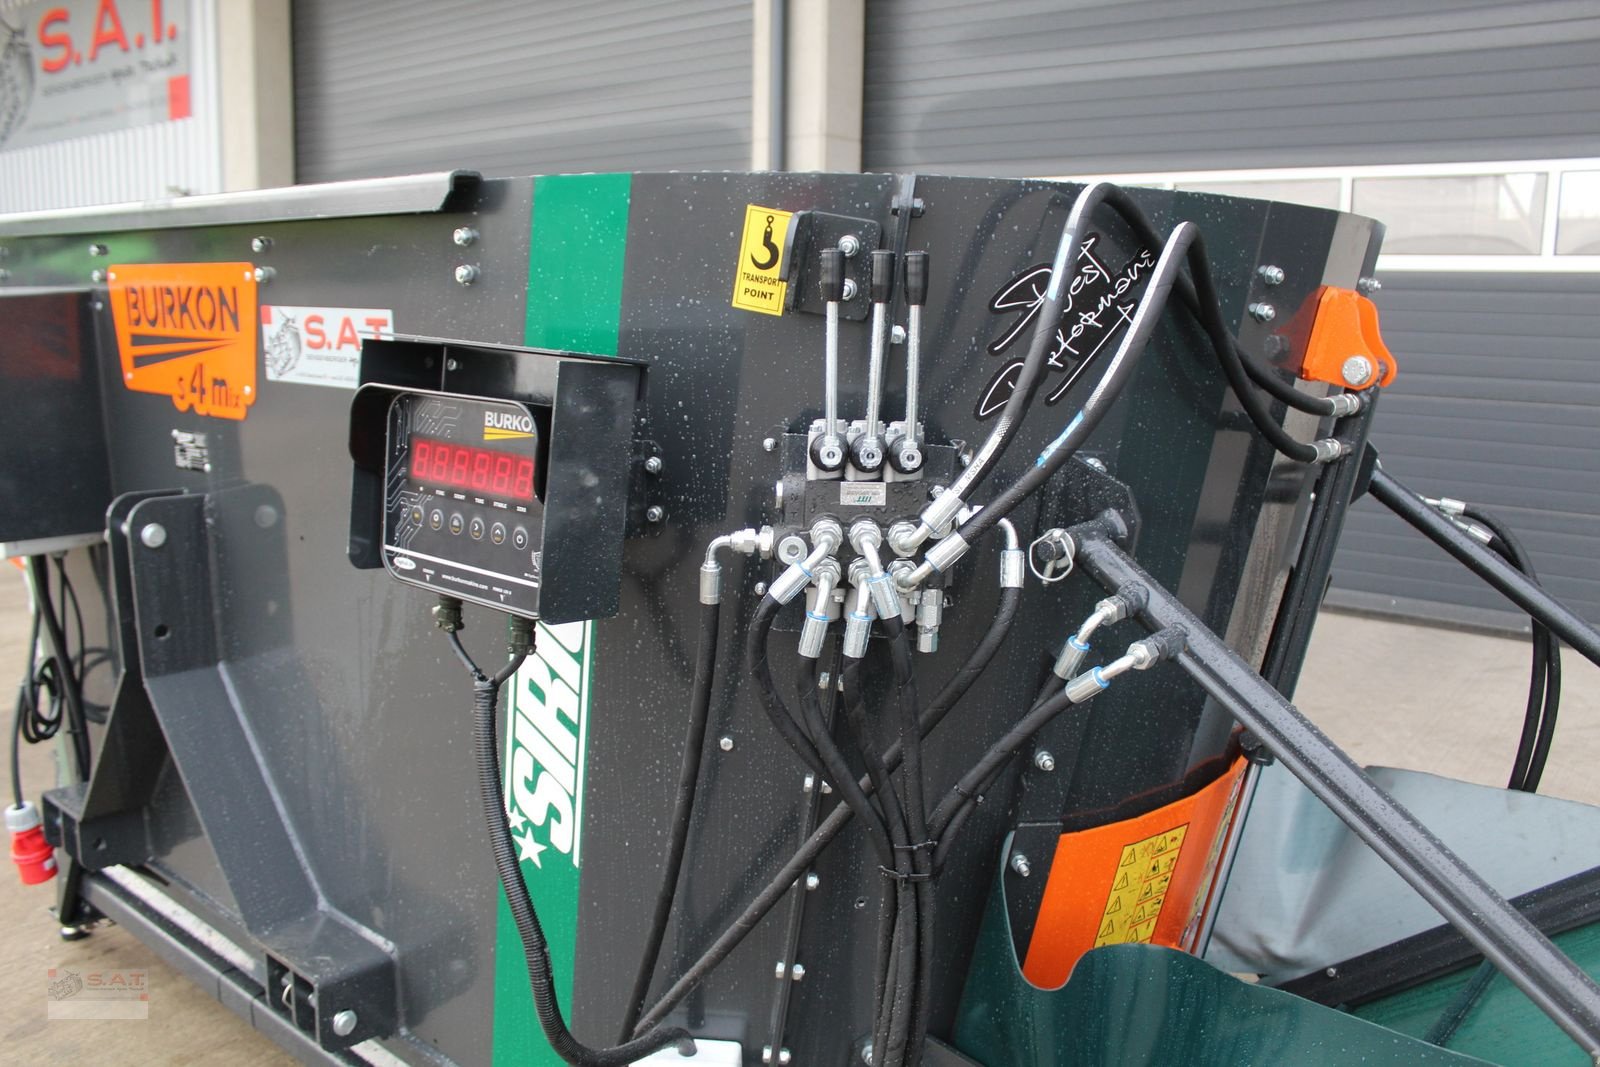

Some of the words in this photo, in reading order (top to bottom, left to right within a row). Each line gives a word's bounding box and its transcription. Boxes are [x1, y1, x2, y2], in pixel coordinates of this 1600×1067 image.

[742, 271, 784, 287] TRANSPORT
[744, 287, 775, 300] POINT
[124, 284, 240, 333] BURKON
[484, 410, 534, 433] BURKO
[513, 619, 585, 854] SIRI
